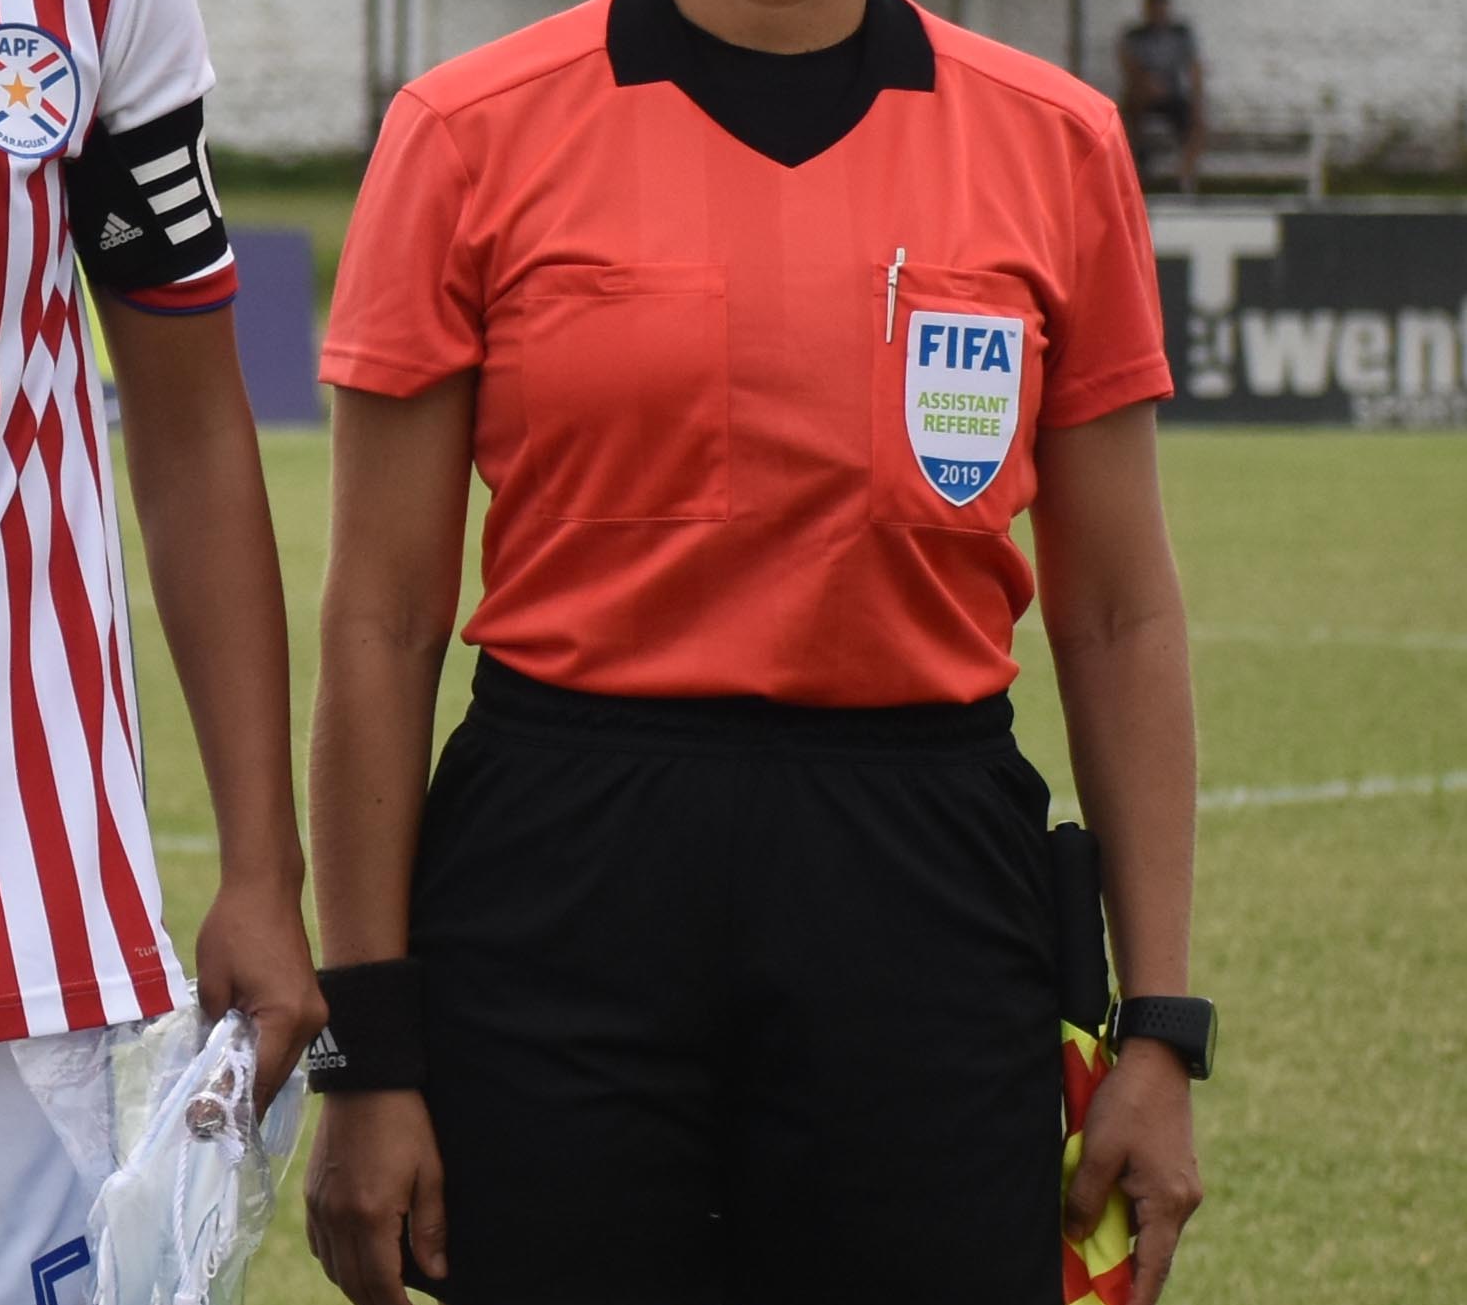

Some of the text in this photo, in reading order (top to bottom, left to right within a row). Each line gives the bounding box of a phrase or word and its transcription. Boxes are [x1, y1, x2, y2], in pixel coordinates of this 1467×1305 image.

[99, 227, 144, 250] adidas
[1150, 208, 1467, 398] Twen
[918, 324, 1011, 373] FIFA
[917, 392, 1009, 415] ASSISTANT
[923, 414, 1001, 436] REFEREE
[938, 464, 981, 486] 2019
